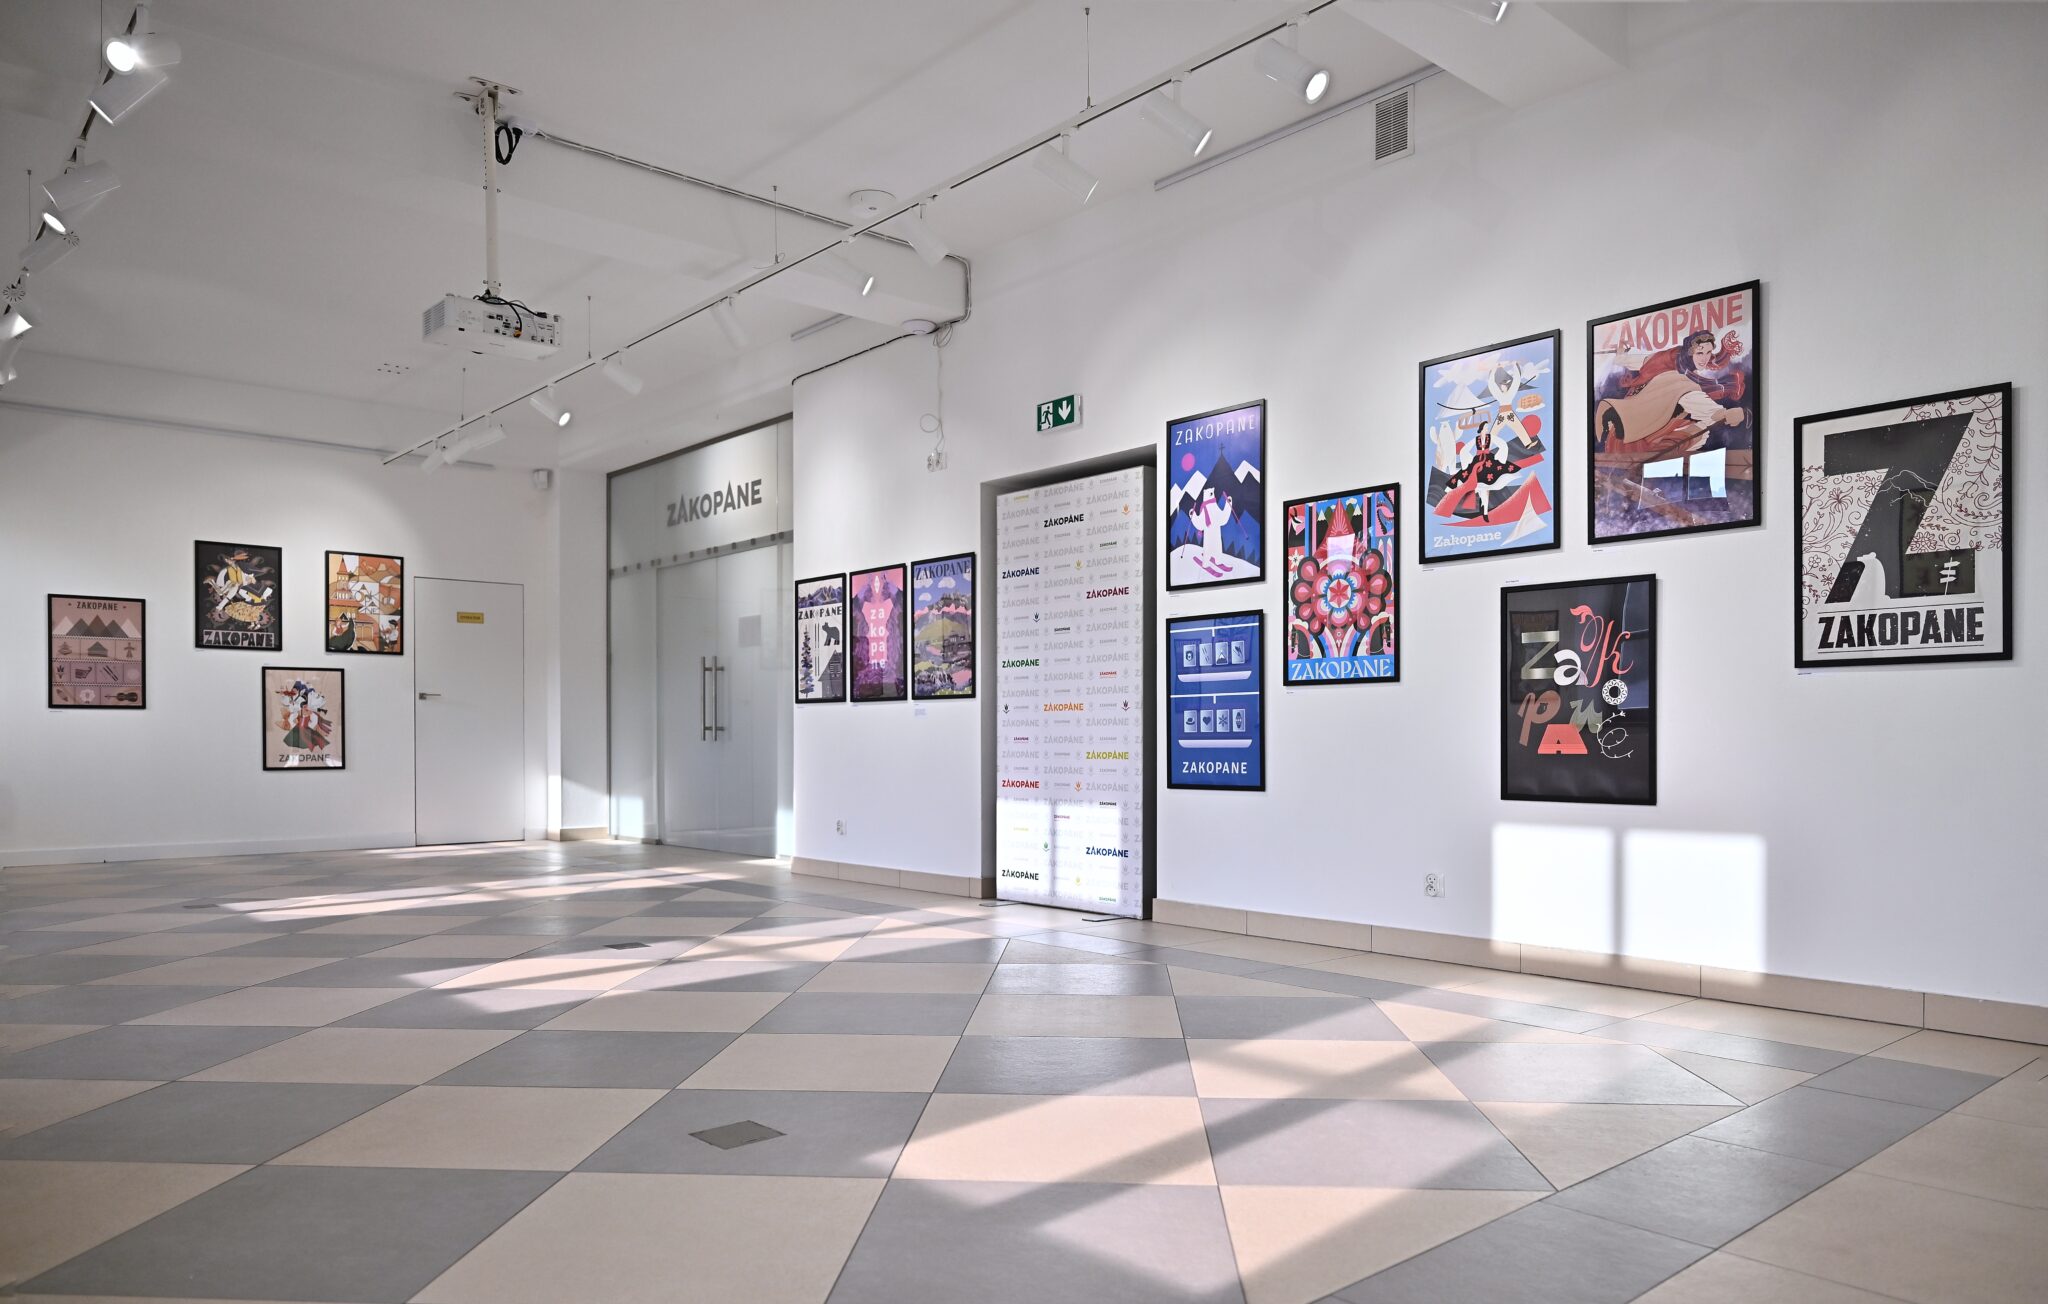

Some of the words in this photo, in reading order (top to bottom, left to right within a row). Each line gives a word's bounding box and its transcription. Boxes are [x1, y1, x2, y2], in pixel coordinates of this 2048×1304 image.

[1602, 293, 1743, 352] ZAKOPANE
[1175, 414, 1255, 446] ZAKOPANE
[666, 478, 763, 527] ZAKOPANE
[1044, 514, 1084, 528] ZAKOPANE
[1433, 531, 1502, 548] Zakopane
[915, 559, 971, 581] ZAKOPANE
[1002, 567, 1040, 579] ZAKOPANE
[1086, 586, 1129, 600] ZAKOPANE
[76, 601, 118, 611] ZAKOPANE
[870, 607, 885, 620] za
[870, 623, 886, 637] ko
[1818, 607, 1984, 649] ZAKOPANE
[203, 630, 274, 648] ZAKOPANE
[871, 640, 886, 657] pa
[1002, 658, 1040, 668] ZAKOPANE
[1291, 658, 1392, 680] ZAKOPANE
[1044, 702, 1084, 712] ZAKOPANE
[278, 753, 331, 763] ZAKOPANE
[1086, 750, 1129, 760] ZAKOPANE
[1182, 761, 1248, 775] ZAKOPANE
[1002, 778, 1040, 788] ZAKOPANE
[1086, 846, 1129, 858] ZAKOPANE
[1002, 868, 1040, 880] ZAKOPANE
